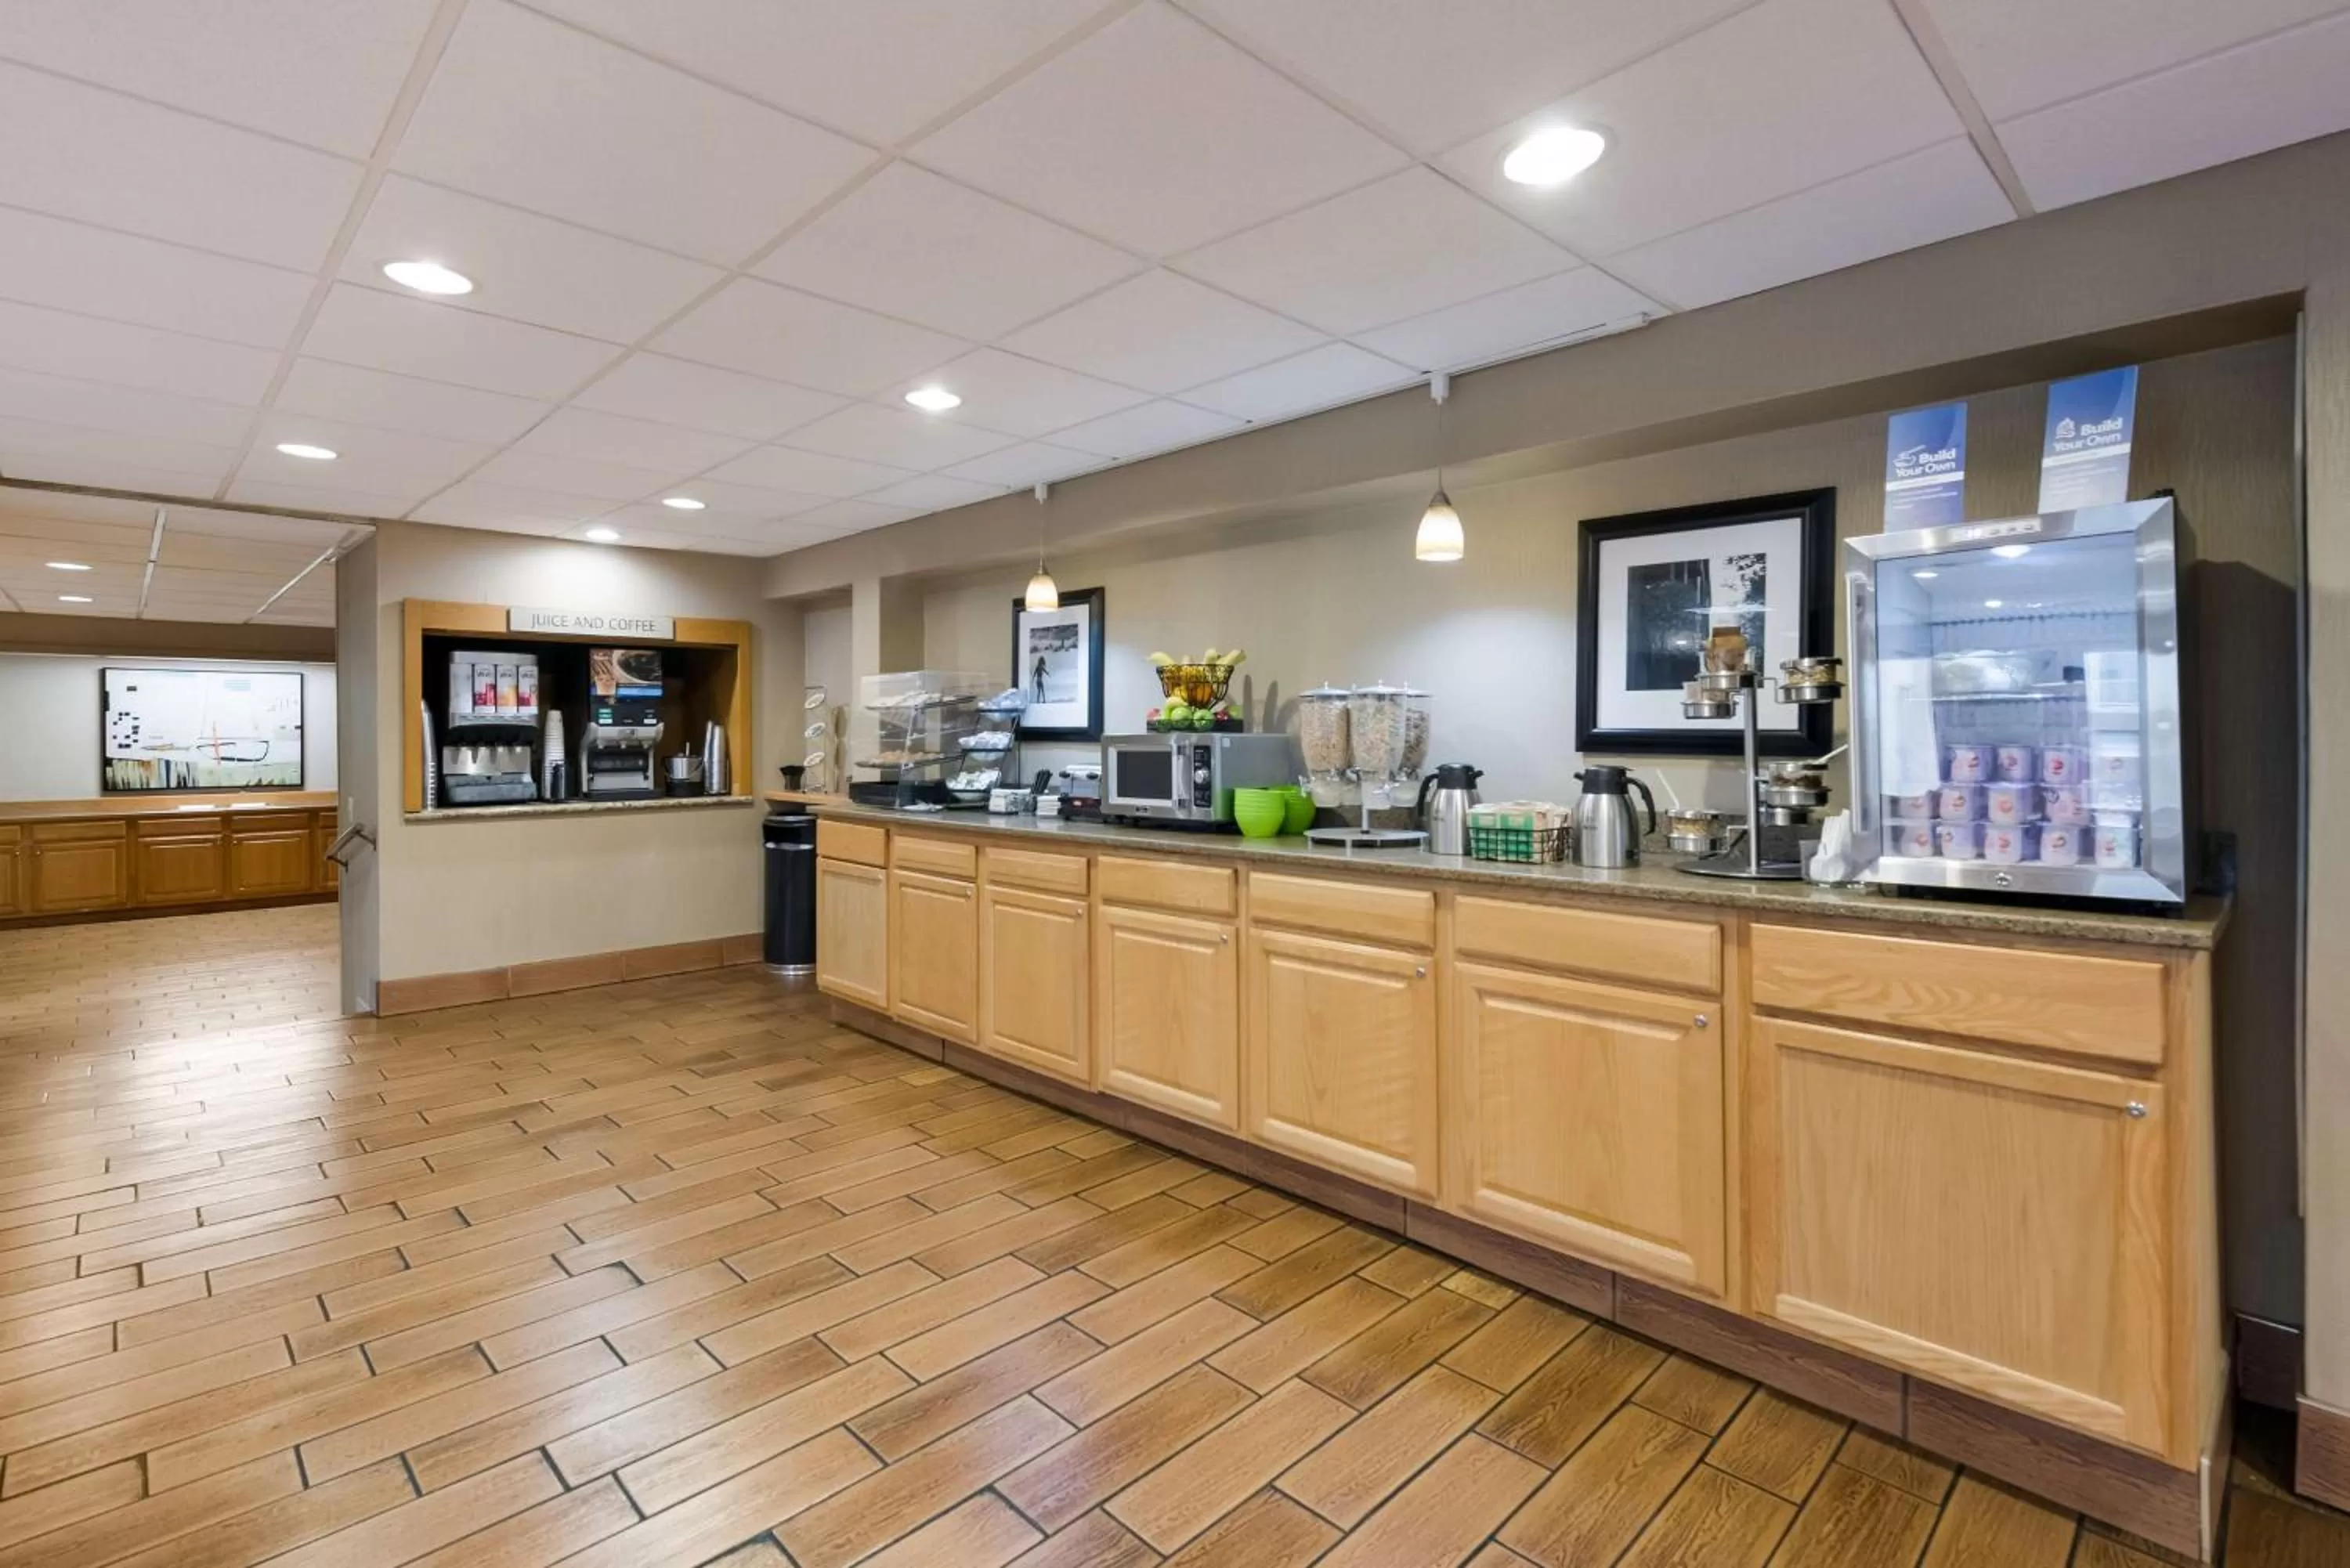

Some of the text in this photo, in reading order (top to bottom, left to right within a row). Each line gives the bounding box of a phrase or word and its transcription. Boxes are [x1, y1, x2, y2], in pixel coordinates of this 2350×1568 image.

[2081, 417, 2124, 435] Build
[2052, 433, 2121, 451] Your Own
[1918, 448, 1956, 464] Build
[1896, 461, 1956, 477] Your Own
[531, 613, 656, 632] JUICE AND COFFEE
